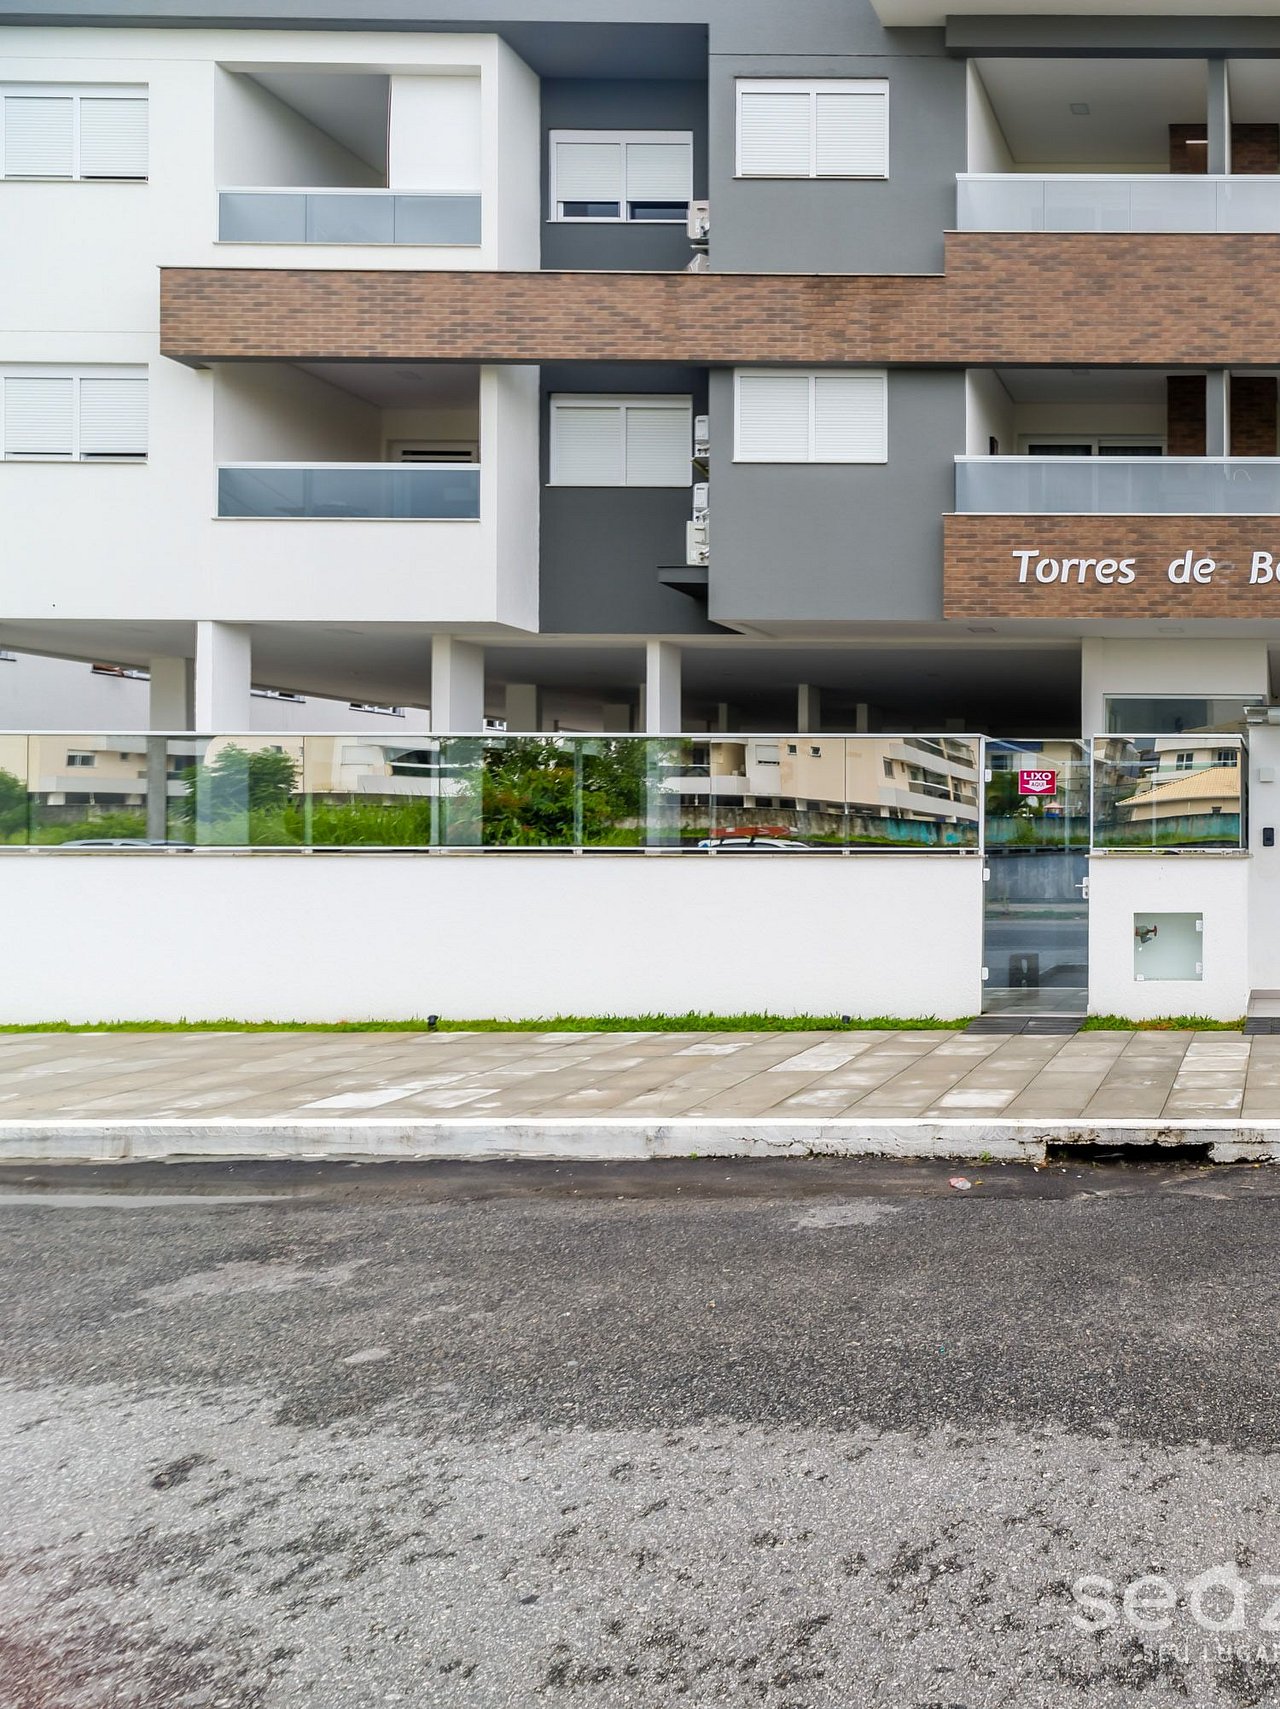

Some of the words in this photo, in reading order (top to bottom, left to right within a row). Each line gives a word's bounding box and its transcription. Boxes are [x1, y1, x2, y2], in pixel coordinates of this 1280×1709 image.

[1012, 549, 1136, 584] Torres
[1167, 549, 1216, 584] de
[1023, 772, 1052, 780] LIXO
